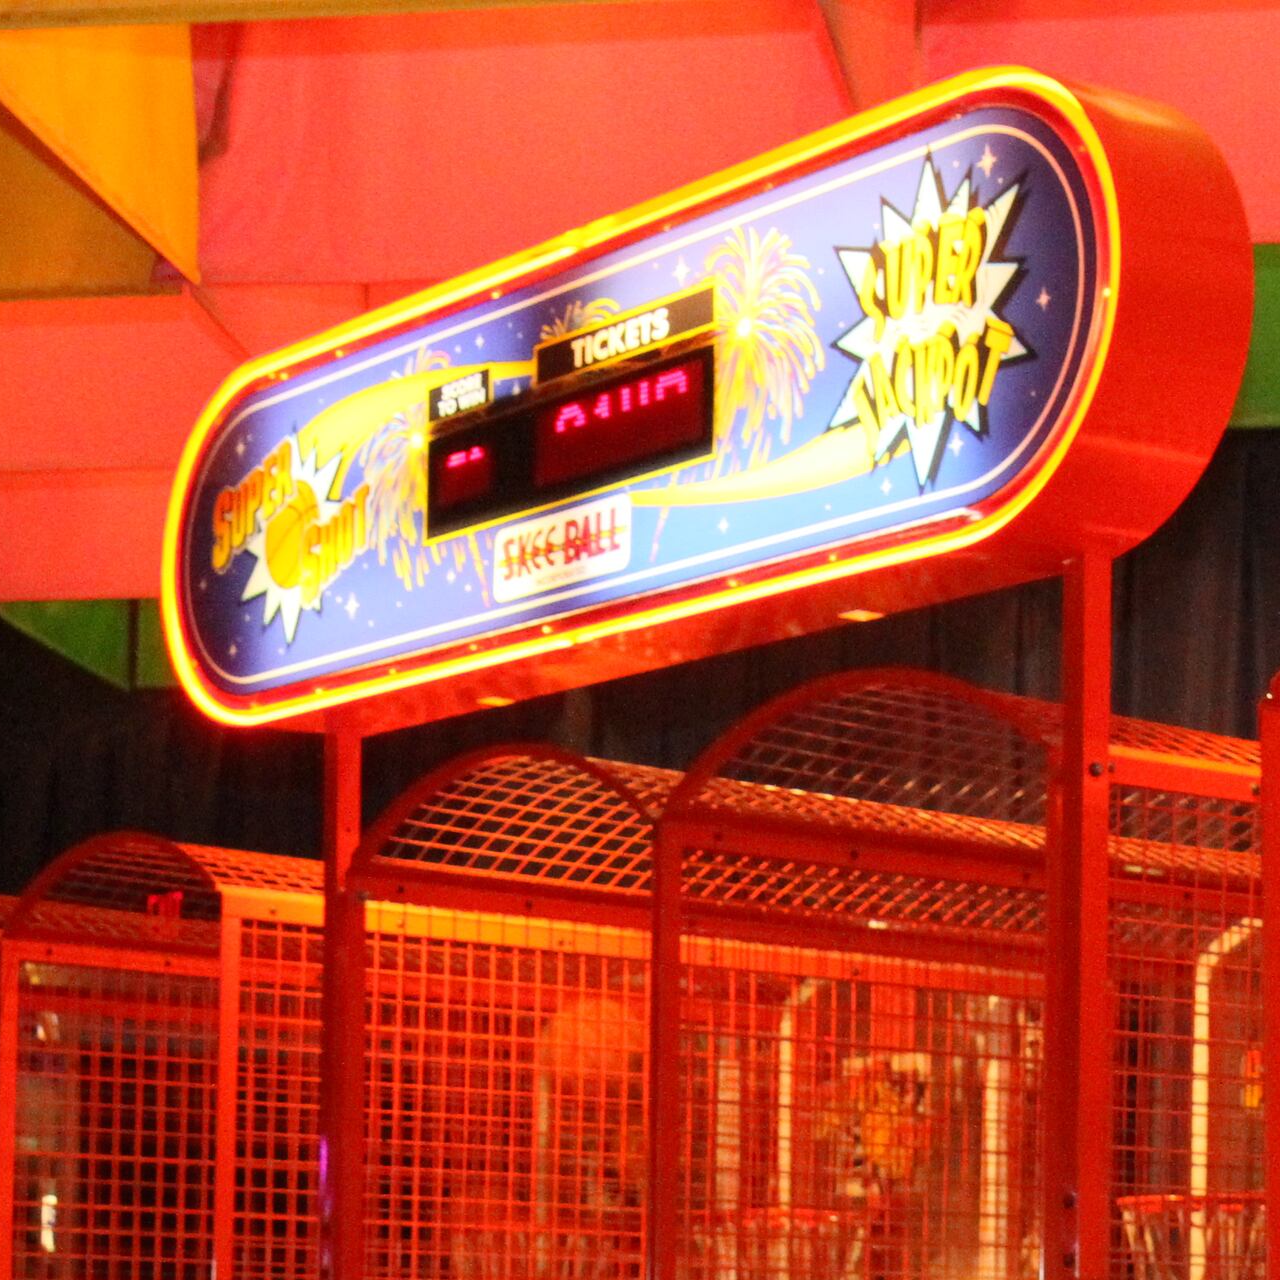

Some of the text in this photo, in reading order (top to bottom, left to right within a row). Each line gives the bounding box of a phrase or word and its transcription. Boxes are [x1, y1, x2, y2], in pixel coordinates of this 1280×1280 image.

[570, 307, 670, 368] TICKETS
[859, 207, 987, 342] SUPER
[851, 316, 1015, 460] JACKPOT
[212, 440, 293, 569] SUPER
[300, 482, 370, 605] SHOT
[503, 508, 620, 580] SKEE BALL
